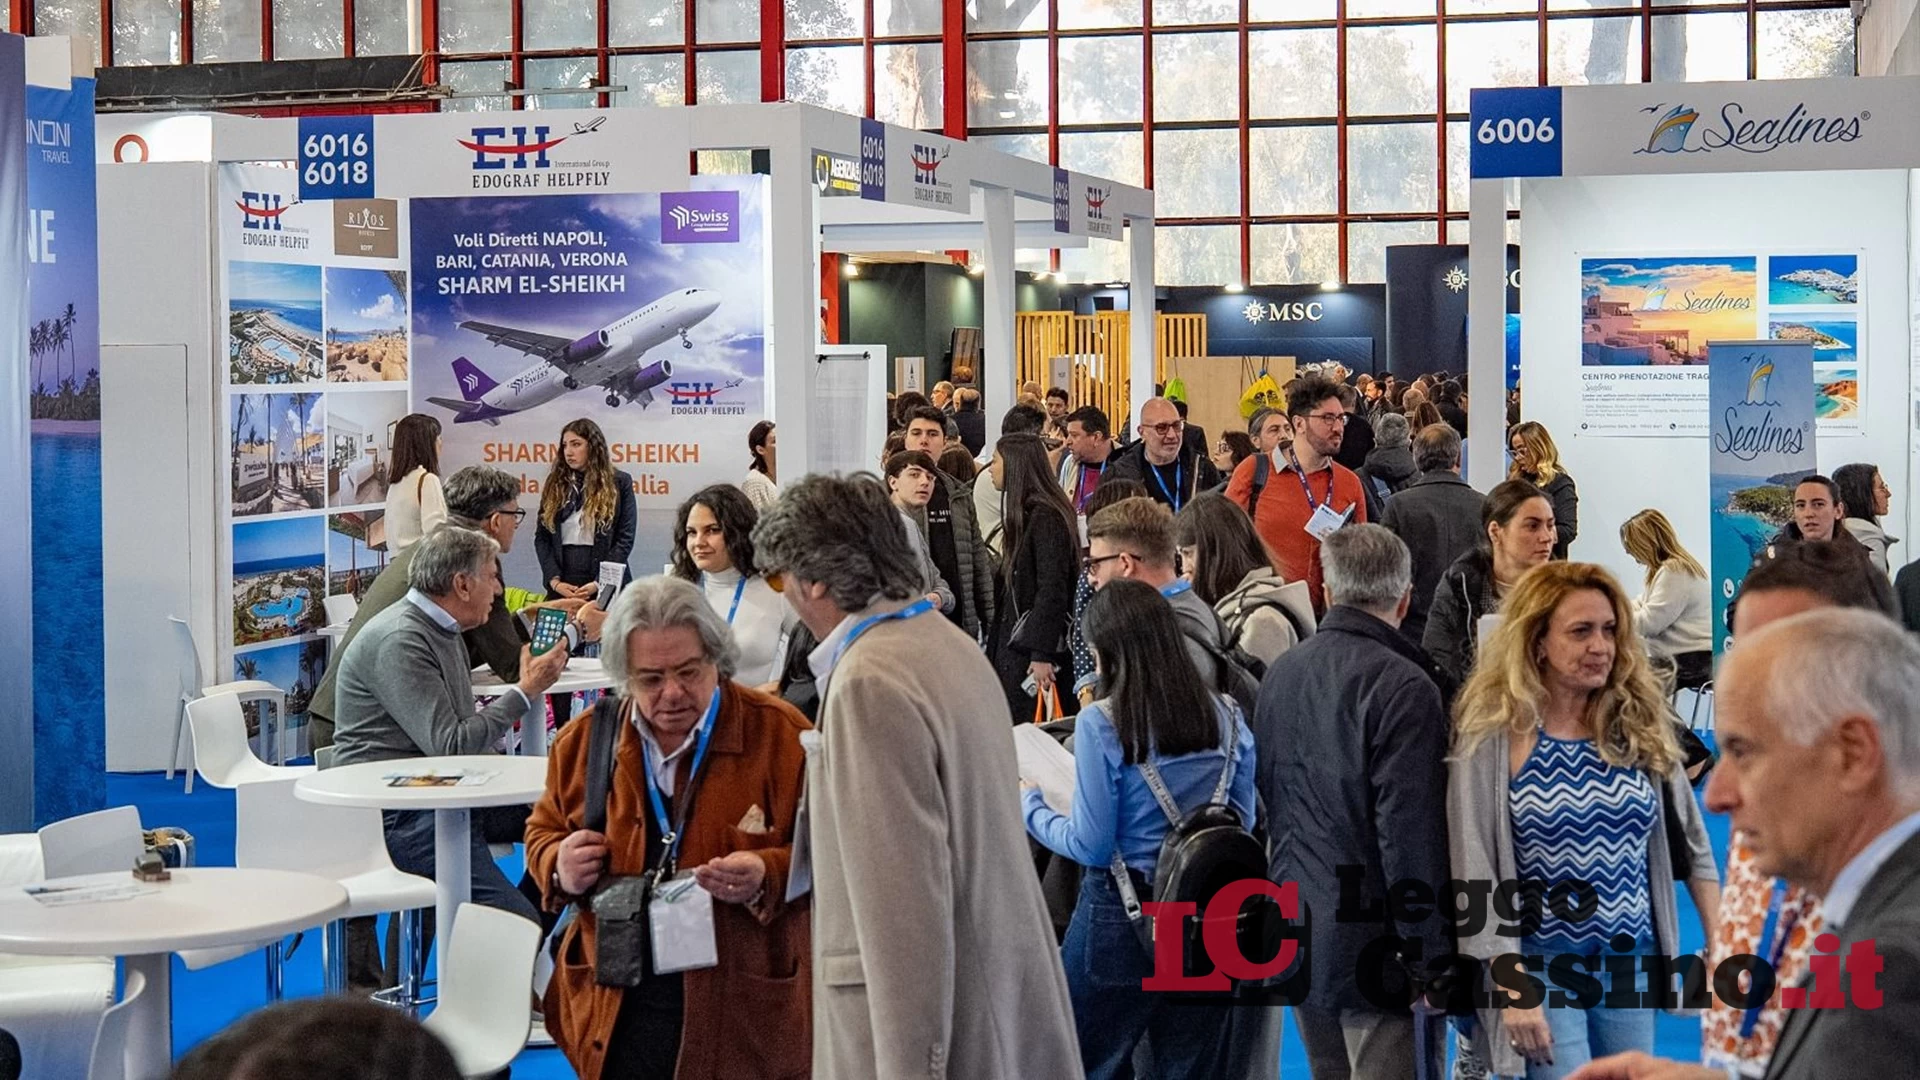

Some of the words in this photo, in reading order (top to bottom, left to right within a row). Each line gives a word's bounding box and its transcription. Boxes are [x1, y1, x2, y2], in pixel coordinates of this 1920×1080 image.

[1477, 117, 1555, 144] 6006
[1703, 102, 1863, 153] Sealines
[304, 133, 368, 158] 6016
[863, 136, 884, 161] 6016
[42, 149, 70, 164] TRAVEL
[304, 161, 368, 185] 6018
[472, 174, 540, 188] EDOGRAF
[548, 172, 610, 187] HELPFLY
[863, 162, 884, 187] 6018
[348, 207, 384, 227] RIXOS
[691, 209, 729, 222] Swiss
[243, 233, 276, 246] EDOGRAF
[280, 235, 309, 249] HELPFLY
[454, 233, 484, 247] Voli
[489, 232, 539, 247] Diretti
[543, 231, 607, 247] NAPOLI,
[436, 254, 477, 270] BARI,
[481, 253, 555, 269] CATANIA,
[560, 253, 628, 267] VERONA
[438, 276, 512, 295] SHARM
[519, 274, 625, 293] EL-SHEIKH
[1675, 288, 1751, 314] Sealines
[1268, 302, 1323, 322] MSC
[671, 406, 708, 415] EDOGRAF
[712, 406, 746, 415] HELPFLY
[1715, 406, 1804, 462] Sealines
